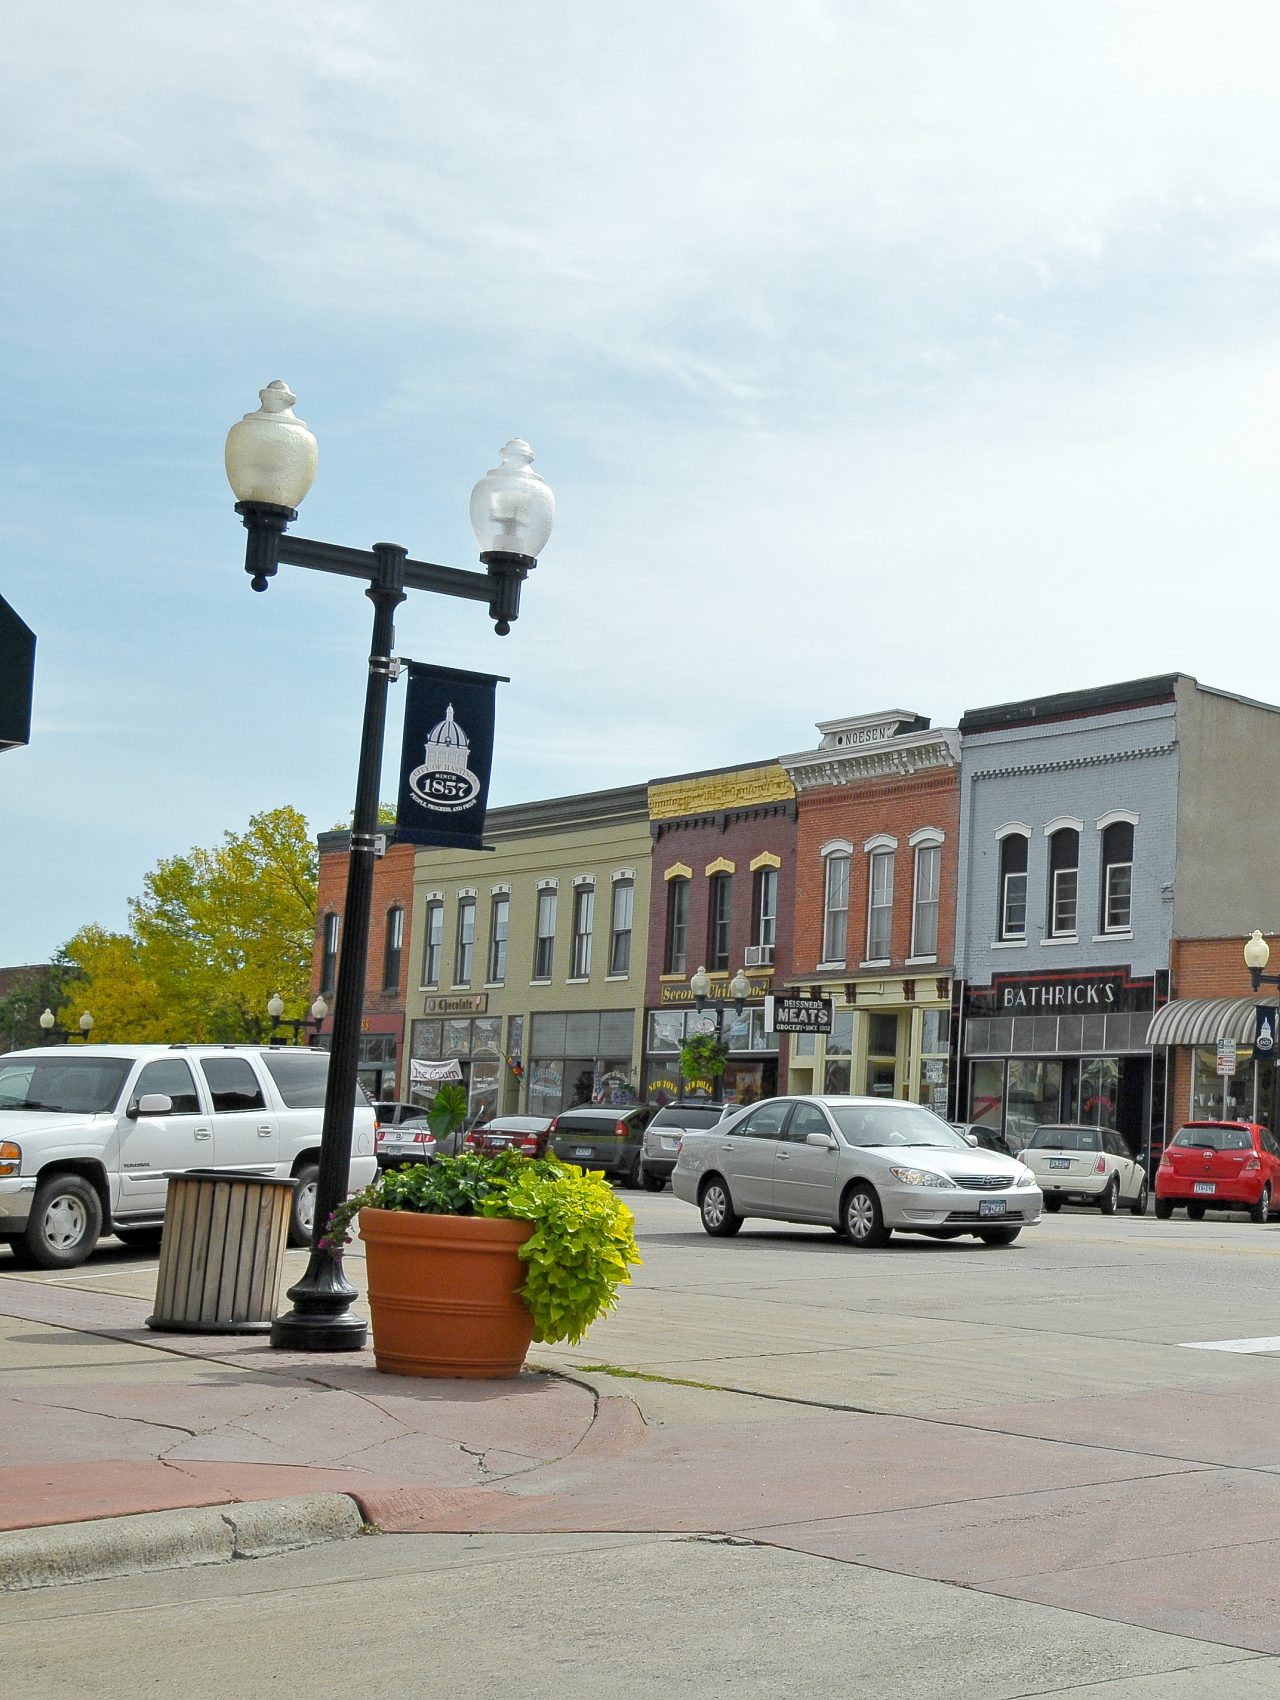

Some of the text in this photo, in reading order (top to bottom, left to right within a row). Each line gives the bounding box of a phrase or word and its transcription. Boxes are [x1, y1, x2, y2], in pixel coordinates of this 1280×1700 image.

[845, 728, 885, 745] NOESEN
[423, 779, 468, 796] 1857
[663, 986, 694, 1000] Secon
[1004, 983, 1115, 1006] BATHRICK'S
[778, 1008, 828, 1023] MEATS
[415, 1068, 460, 1079] Ice Cream
